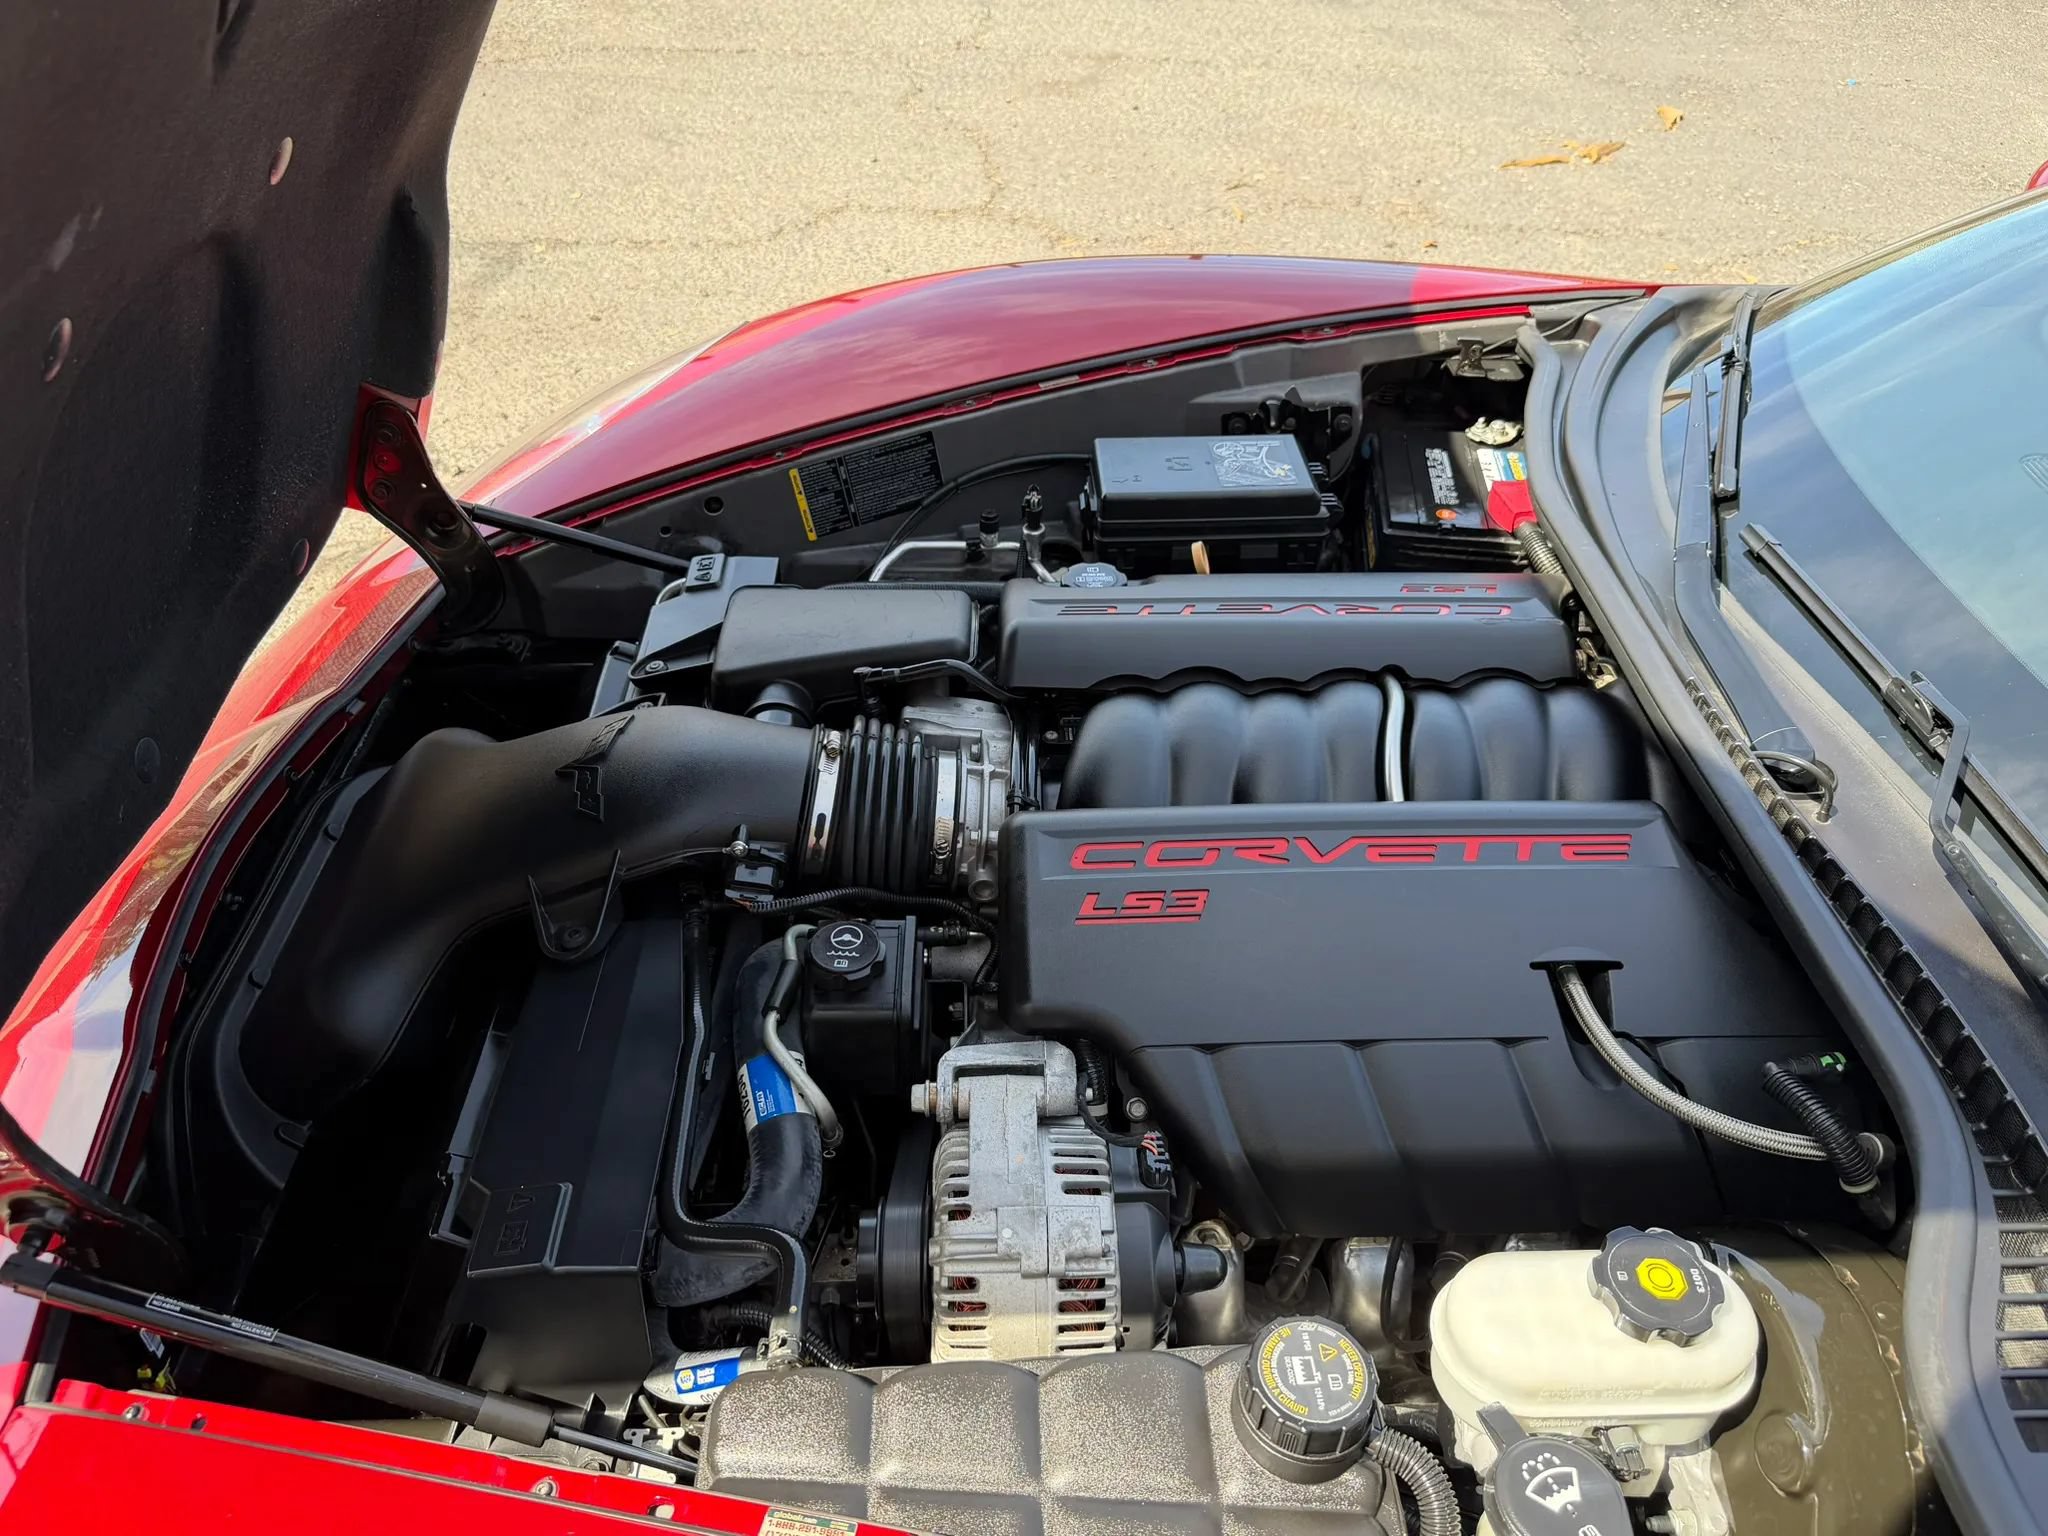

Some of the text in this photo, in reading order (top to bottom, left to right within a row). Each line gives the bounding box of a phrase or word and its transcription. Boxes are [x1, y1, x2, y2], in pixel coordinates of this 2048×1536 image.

[1401, 583, 1498, 594] LS3
[1057, 603, 1513, 617] CORVETTE
[1069, 833, 1633, 870] CORVETTE
[1075, 888, 1211, 919] LS3
[1338, 1338, 1359, 1362] NEVER
[1352, 1361, 1364, 1382] OPEN
